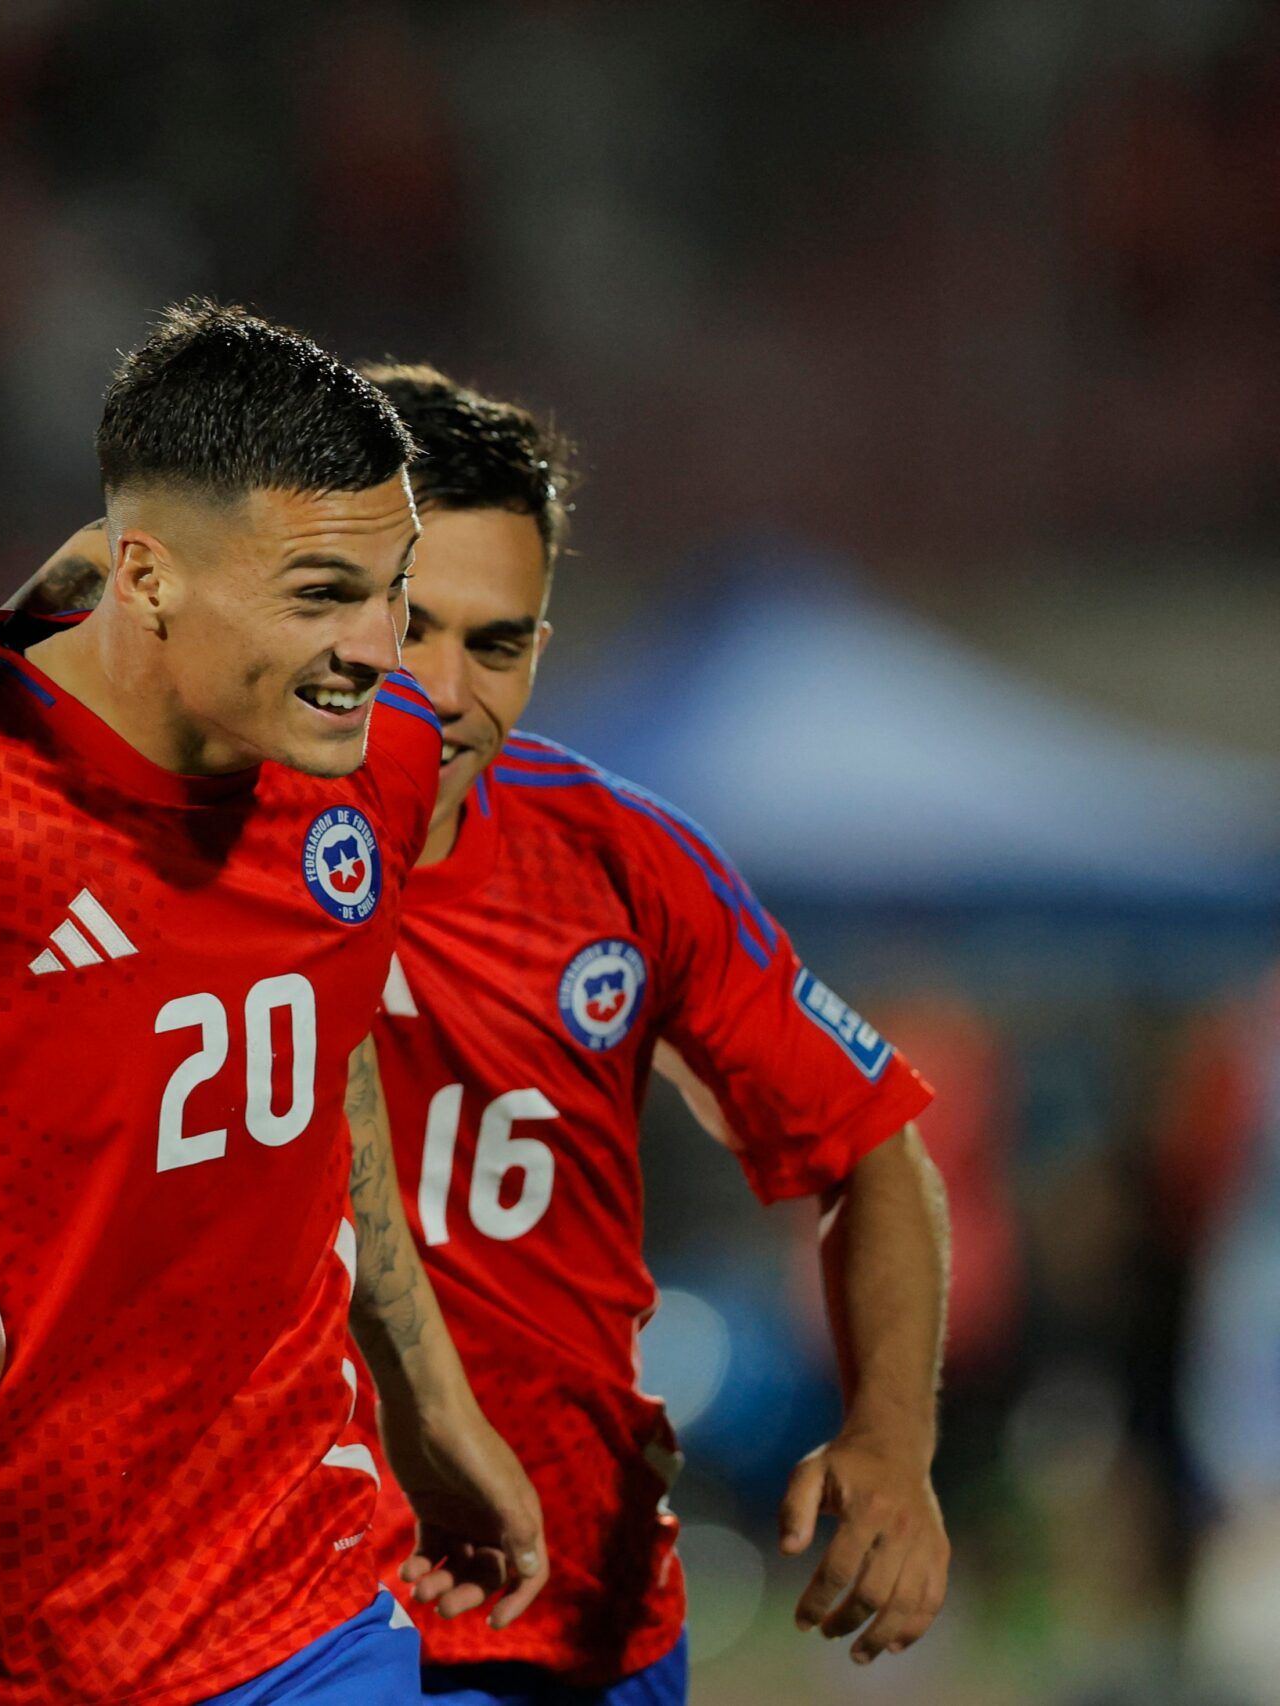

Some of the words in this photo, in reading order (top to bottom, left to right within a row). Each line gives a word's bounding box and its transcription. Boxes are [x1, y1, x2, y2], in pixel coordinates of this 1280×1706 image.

[304, 813, 334, 883] FEDERACION
[337, 809, 350, 824] DE
[352, 814, 377, 855] FUTBOL
[342, 905, 355, 920] DE
[154, 972, 317, 1174] 20
[417, 1083, 561, 1247] 16
